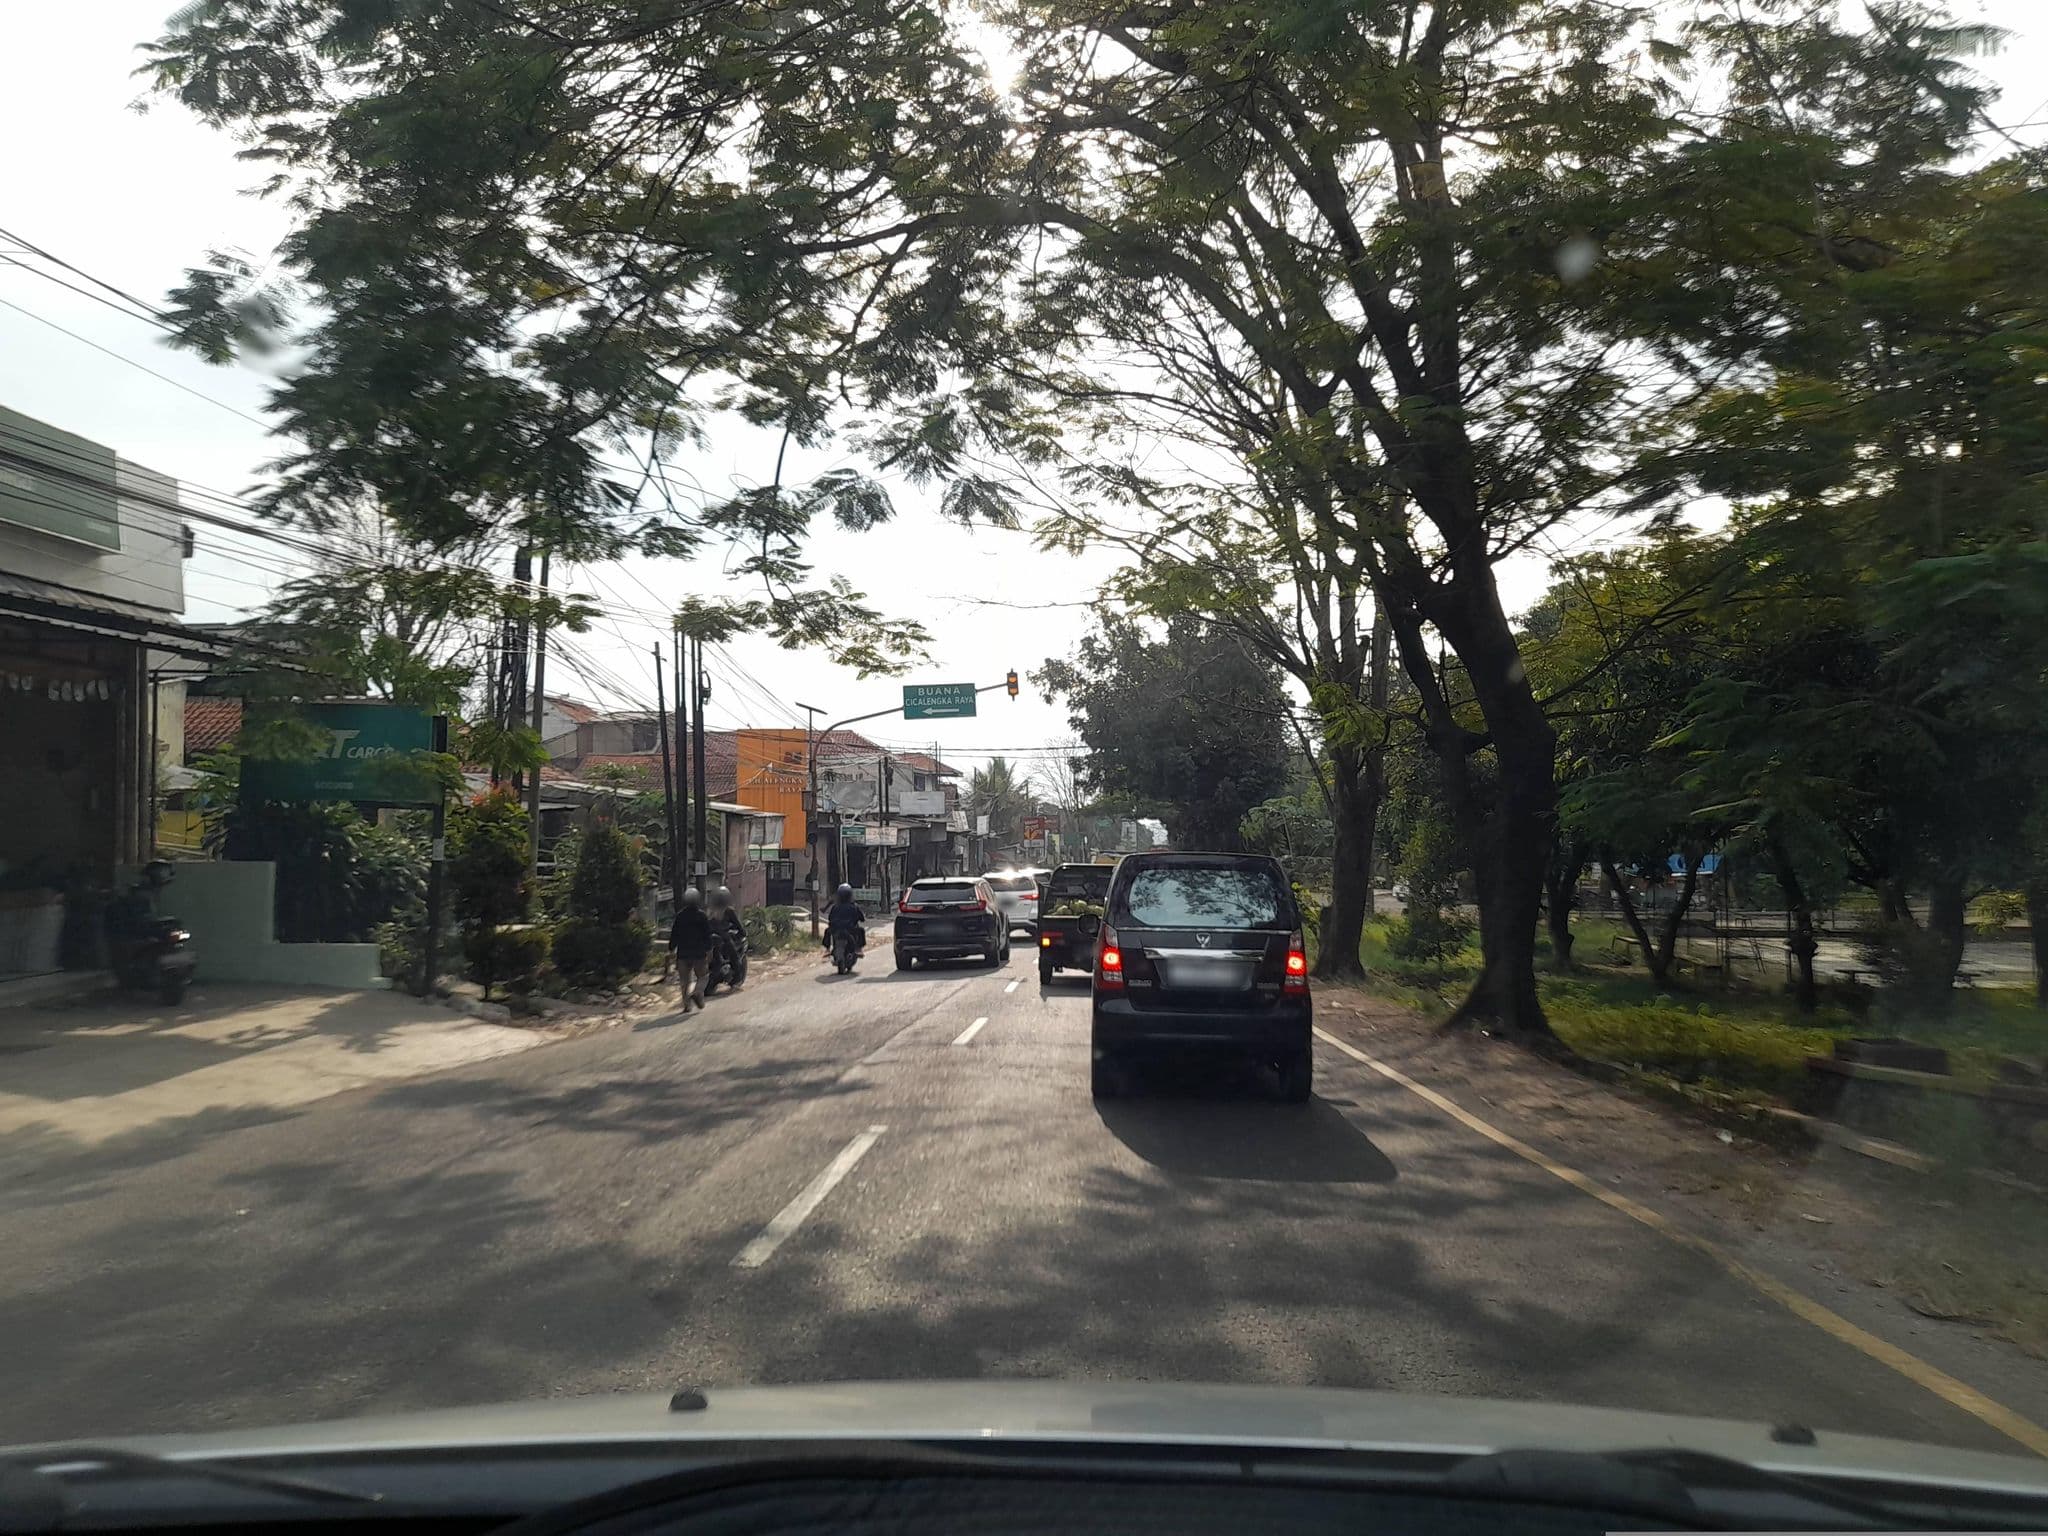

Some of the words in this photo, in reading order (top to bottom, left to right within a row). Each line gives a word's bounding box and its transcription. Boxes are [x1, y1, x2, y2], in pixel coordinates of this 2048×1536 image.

[917, 687, 961, 696] BUANA
[905, 697, 953, 706] CICALENGKA
[954, 696, 975, 705] RAYA
